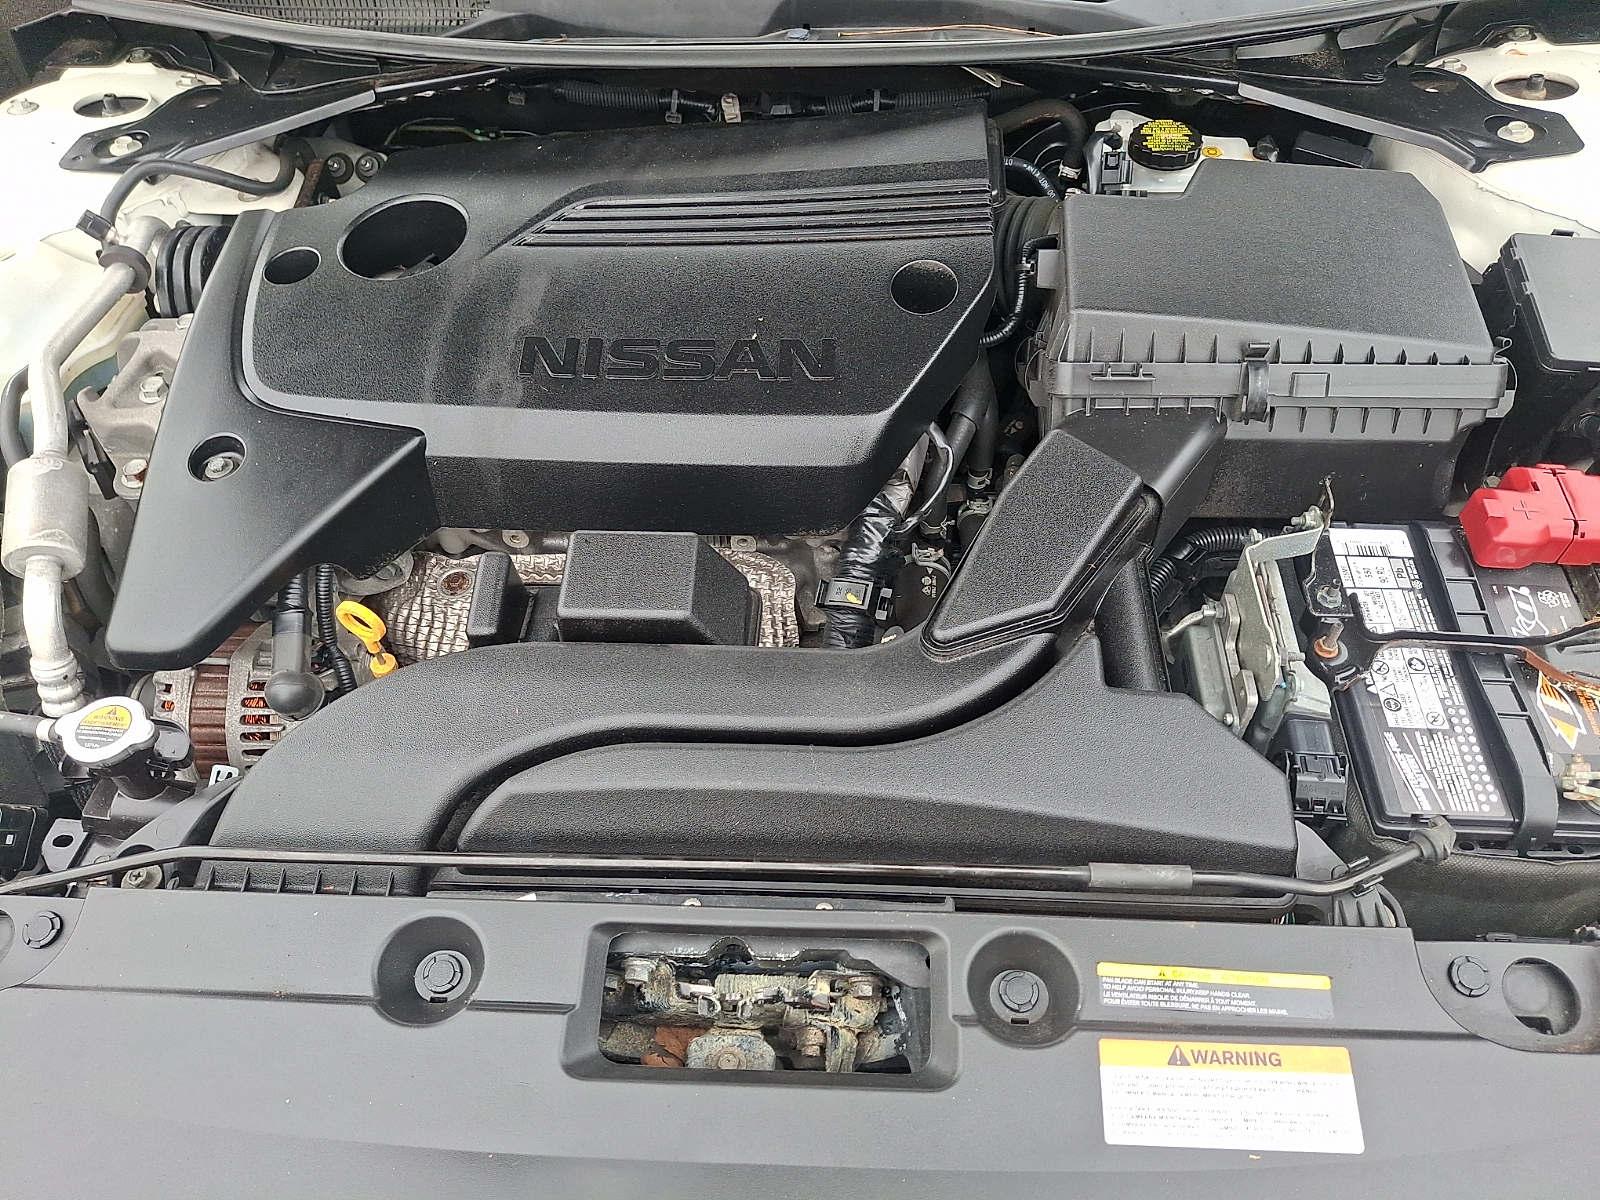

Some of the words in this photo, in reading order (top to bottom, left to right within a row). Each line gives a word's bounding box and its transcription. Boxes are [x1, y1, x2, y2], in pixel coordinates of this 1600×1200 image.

[1025, 165, 1041, 178] KINK
[1038, 177, 1050, 189] NOT
[518, 336, 835, 381] NISSAN
[1395, 568, 1406, 579] Pb
[94, 714, 124, 722] WARNING
[1172, 970, 1211, 979] CAUTION
[1221, 974, 1269, 983] ATTENTION
[1180, 994, 1209, 1003] DÉMARRER
[1231, 991, 1251, 999] CLEAR.
[1121, 998, 1140, 1006] ÉVITER
[1190, 1049, 1282, 1067] WARNING
